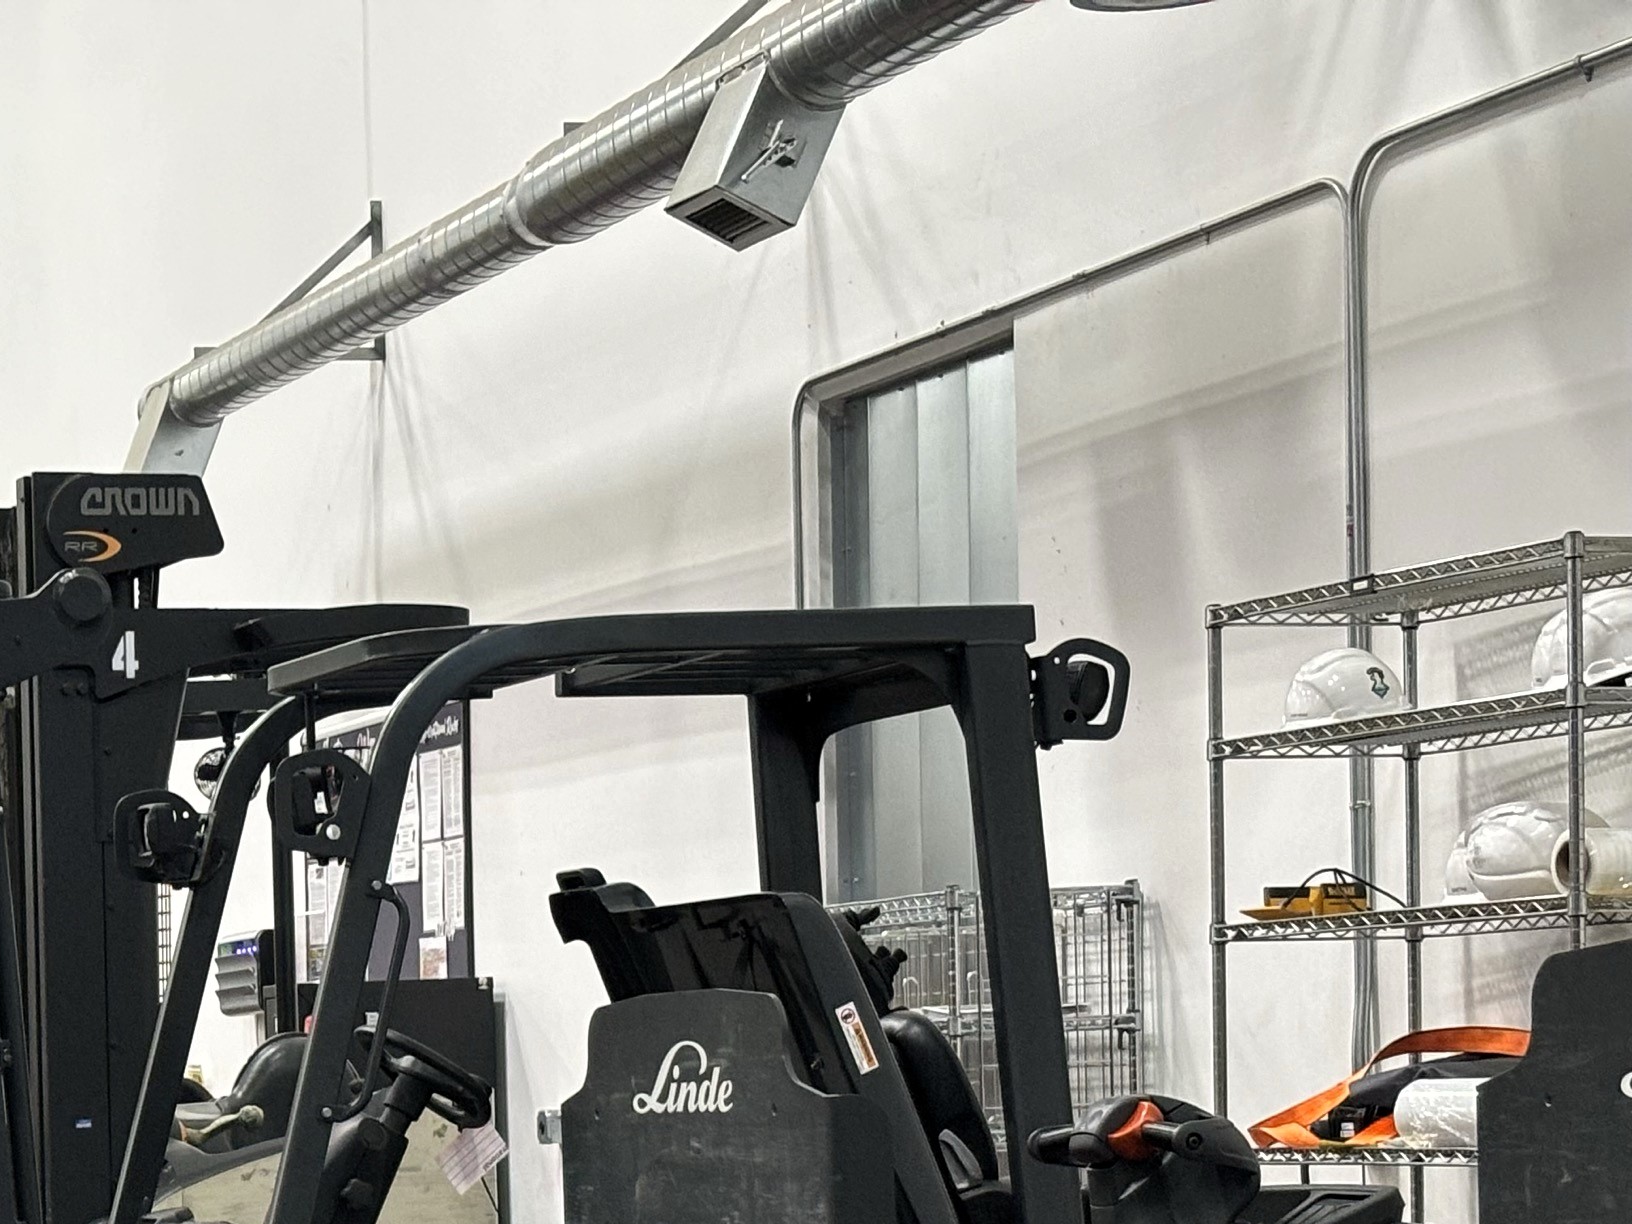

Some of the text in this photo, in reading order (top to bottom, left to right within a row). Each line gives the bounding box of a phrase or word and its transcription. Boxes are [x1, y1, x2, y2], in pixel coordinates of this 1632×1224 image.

[80, 486, 200, 516] CROWN
[64, 541, 98, 552] RR
[111, 630, 140, 679] 4
[632, 1040, 734, 1114] Linde
